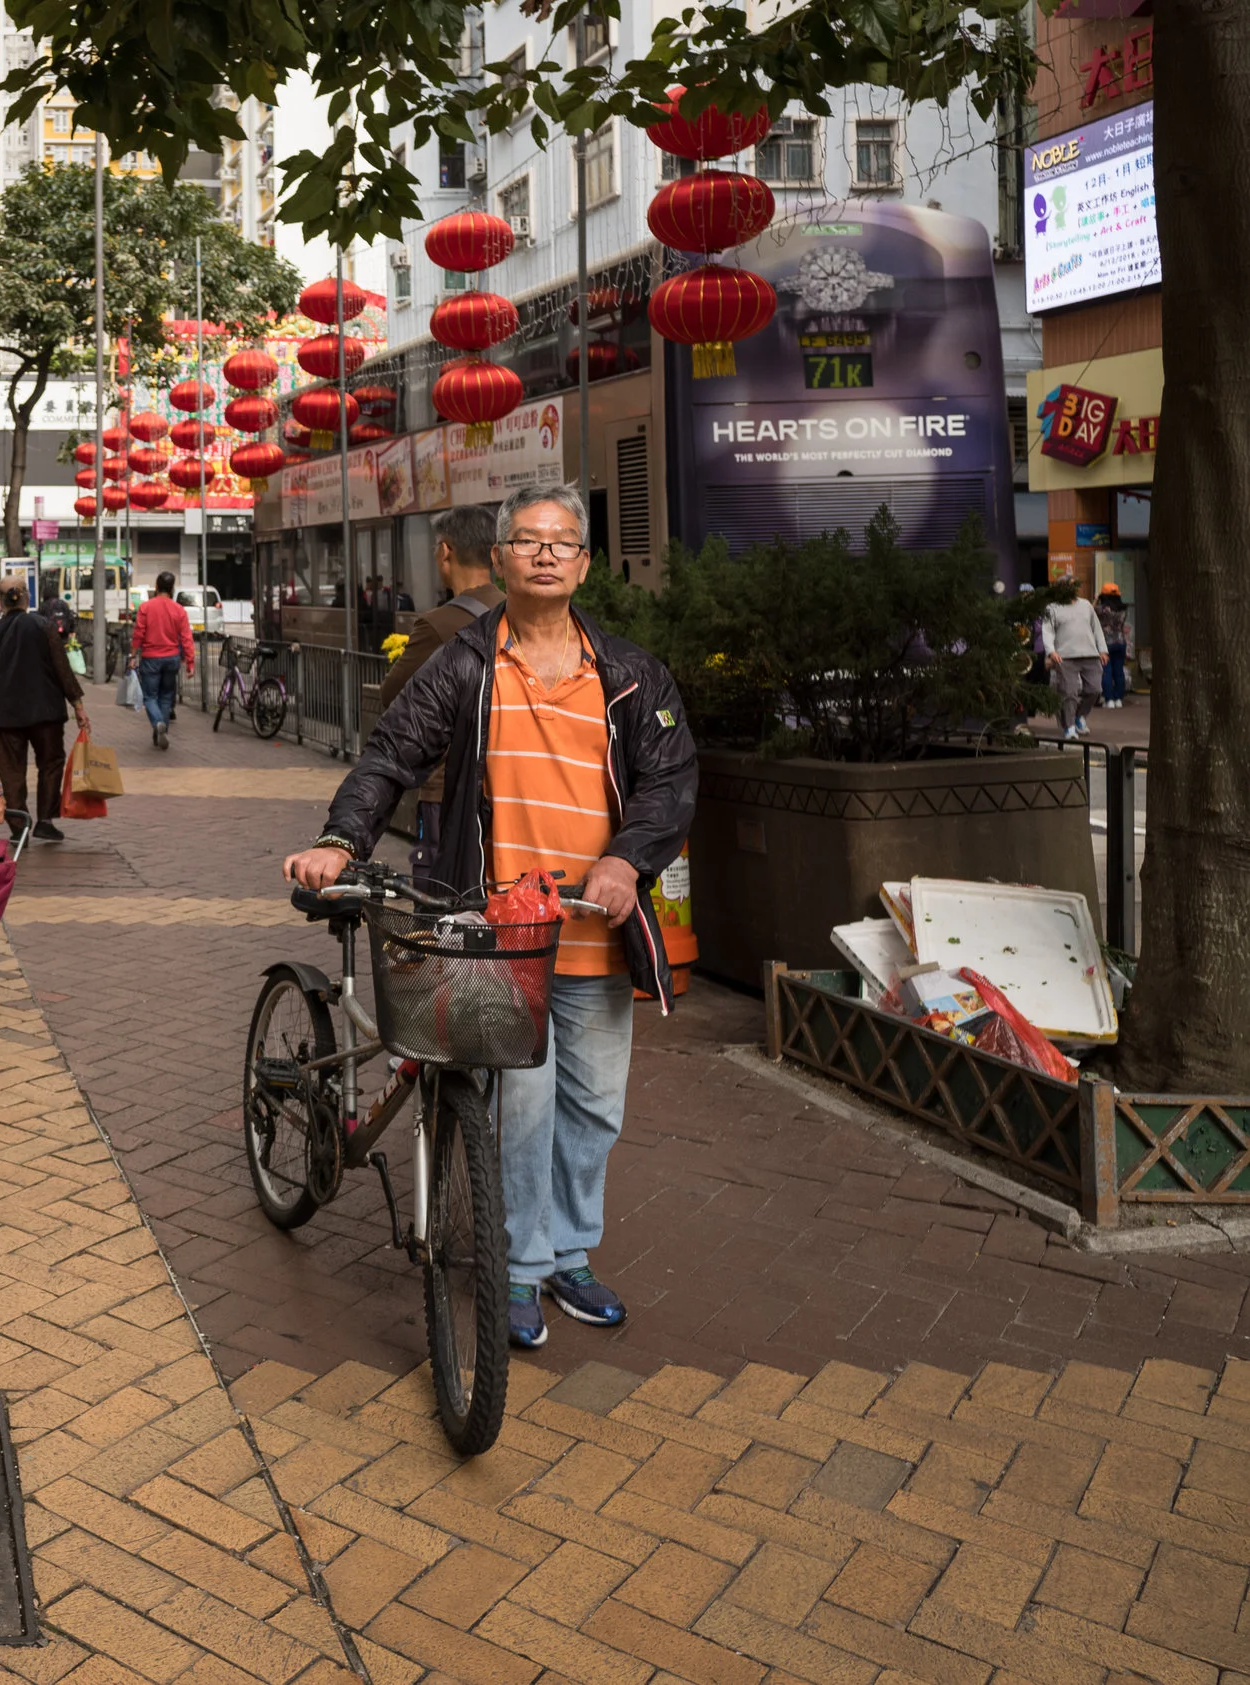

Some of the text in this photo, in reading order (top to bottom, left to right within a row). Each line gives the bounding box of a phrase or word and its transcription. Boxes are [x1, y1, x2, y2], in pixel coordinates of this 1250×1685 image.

[1031, 139, 1081, 172] NOBLE
[1062, 392, 1105, 422] BIG
[713, 414, 967, 443] HEARTS ON FIRE
[1058, 416, 1101, 445] DAY
[734, 447, 954, 462] THE WORLD'S MOST PERFECTLY CUT DIAMOND
